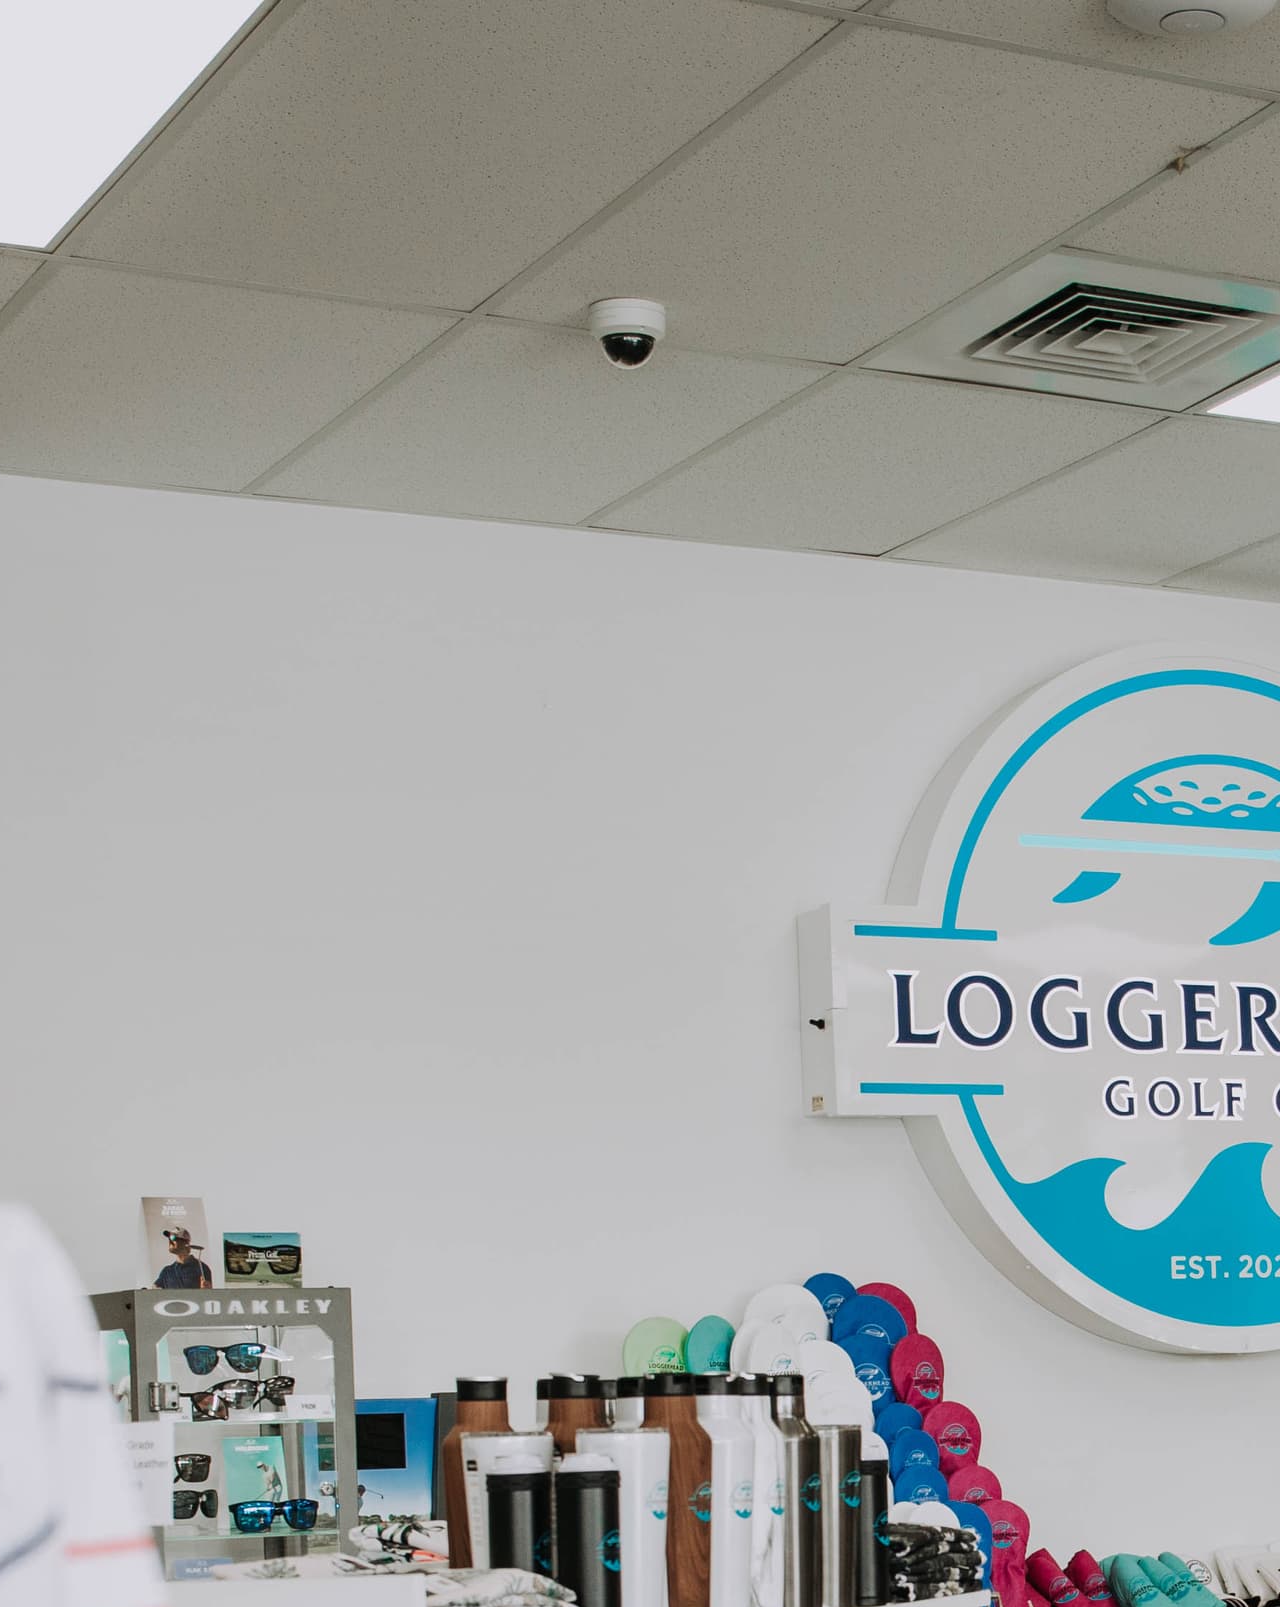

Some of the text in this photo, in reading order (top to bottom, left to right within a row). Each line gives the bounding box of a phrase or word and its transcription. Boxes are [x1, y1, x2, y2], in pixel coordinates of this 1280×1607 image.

[1102, 1074, 1246, 1121] GOLF
[1170, 1255, 1229, 1280] EST.
[204, 1299, 332, 1315] OAKLEY
